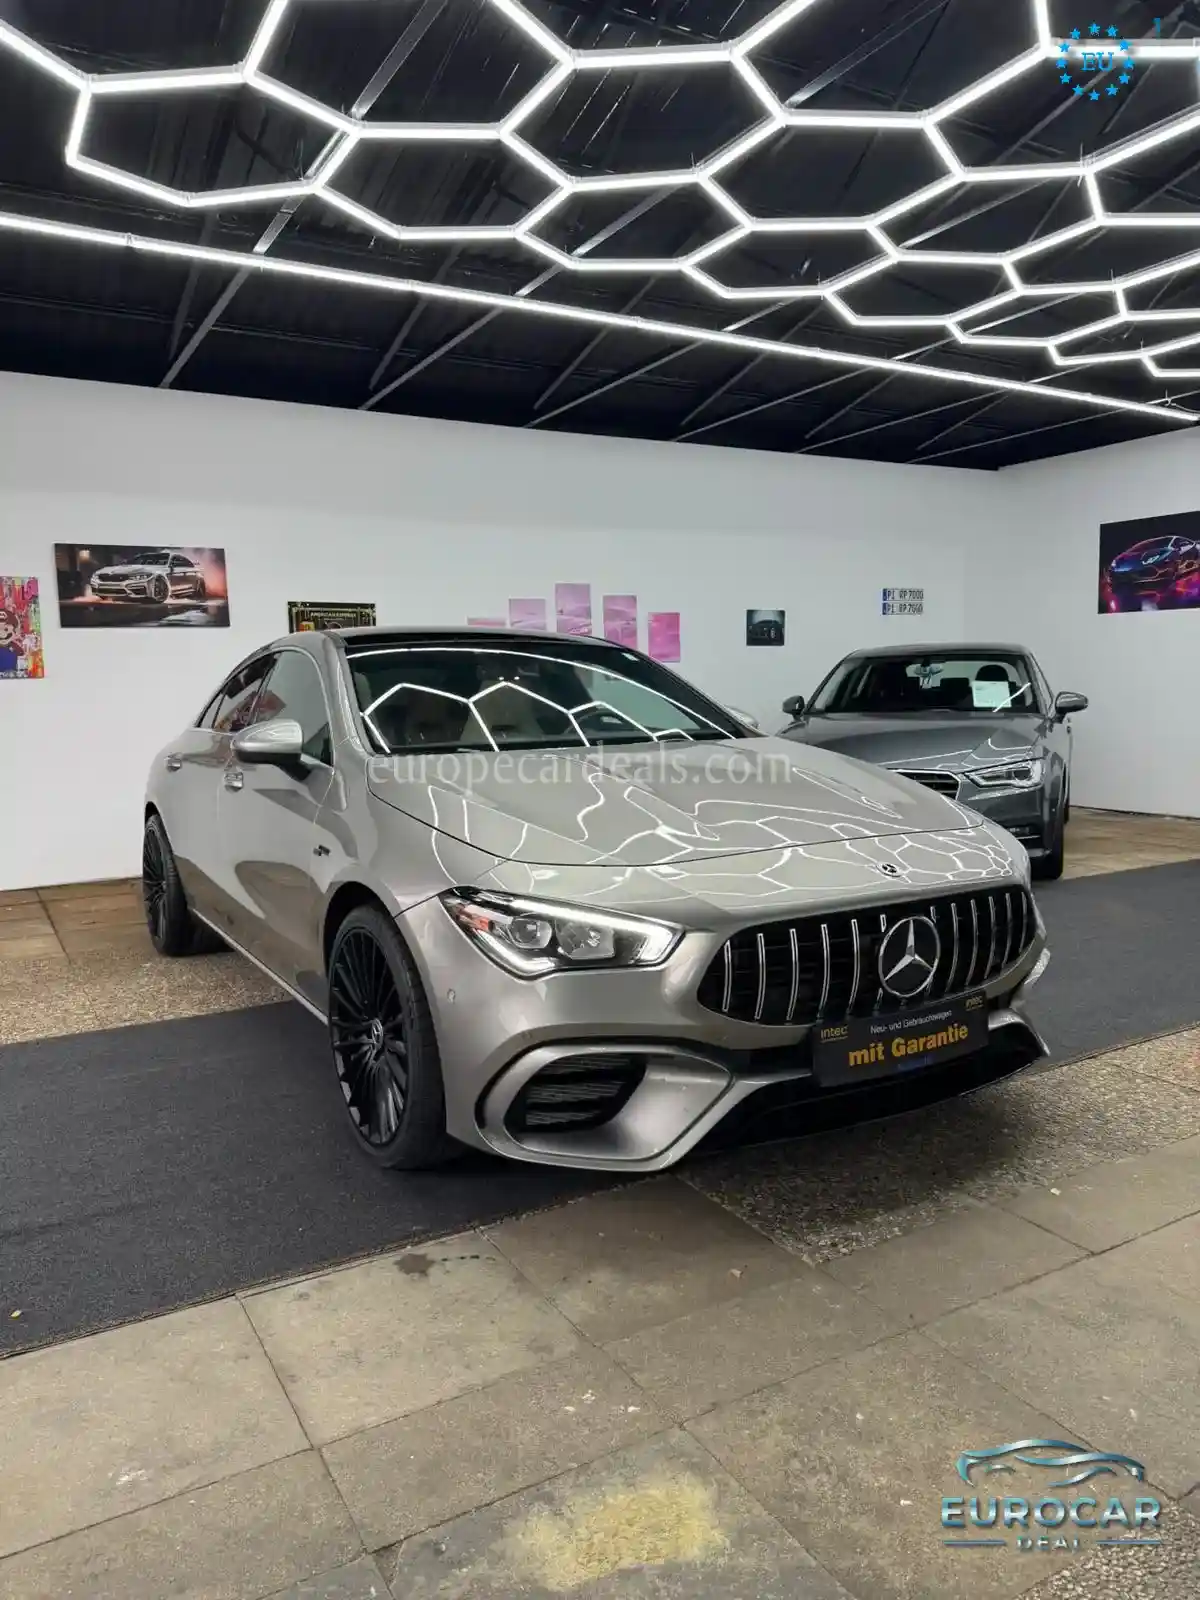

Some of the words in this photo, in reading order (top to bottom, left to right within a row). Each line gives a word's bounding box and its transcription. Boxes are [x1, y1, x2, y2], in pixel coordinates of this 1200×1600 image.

[890, 1021, 902, 1032] und
[849, 1041, 885, 1067] mit
[891, 1022, 969, 1058] Garantie
